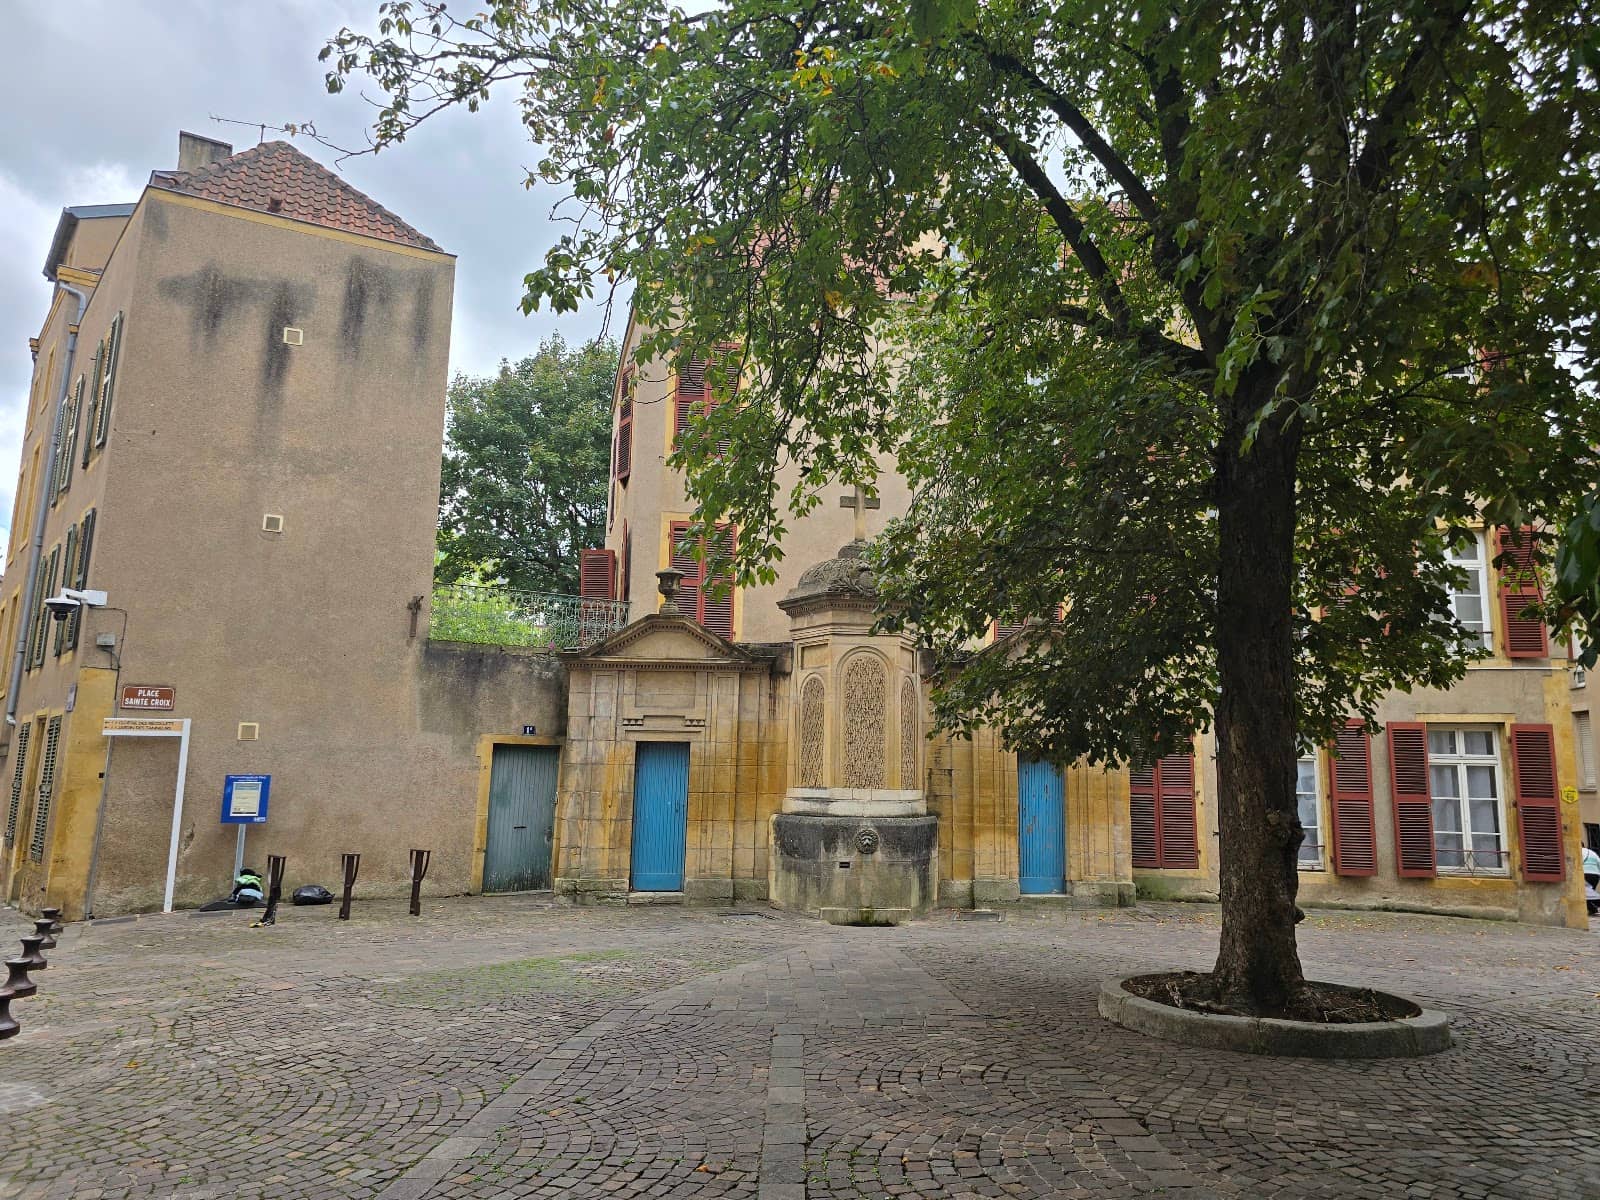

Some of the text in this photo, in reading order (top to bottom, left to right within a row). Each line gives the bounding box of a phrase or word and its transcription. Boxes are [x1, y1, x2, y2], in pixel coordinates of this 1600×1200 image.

[137, 689, 160, 697] PLACE
[124, 697, 171, 707] SAINTE CROIX
